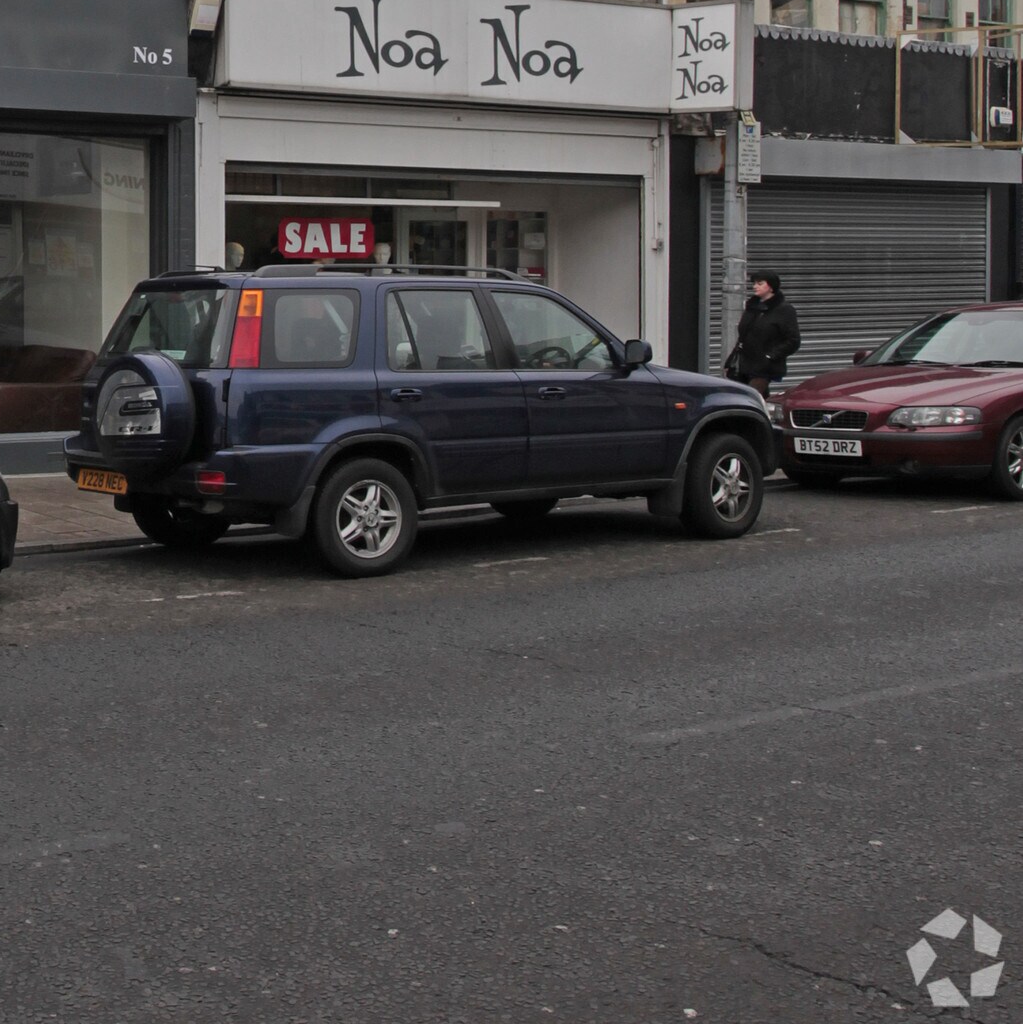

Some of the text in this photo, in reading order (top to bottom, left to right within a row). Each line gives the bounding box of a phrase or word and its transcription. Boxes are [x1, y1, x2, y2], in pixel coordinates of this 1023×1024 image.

[480, 4, 584, 86] Noa
[678, 16, 731, 58] Noa
[133, 46, 173, 66] No 5
[675, 60, 729, 101] Noa
[285, 222, 367, 253] SALE
[799, 439, 857, 453] BT52 DRZ
